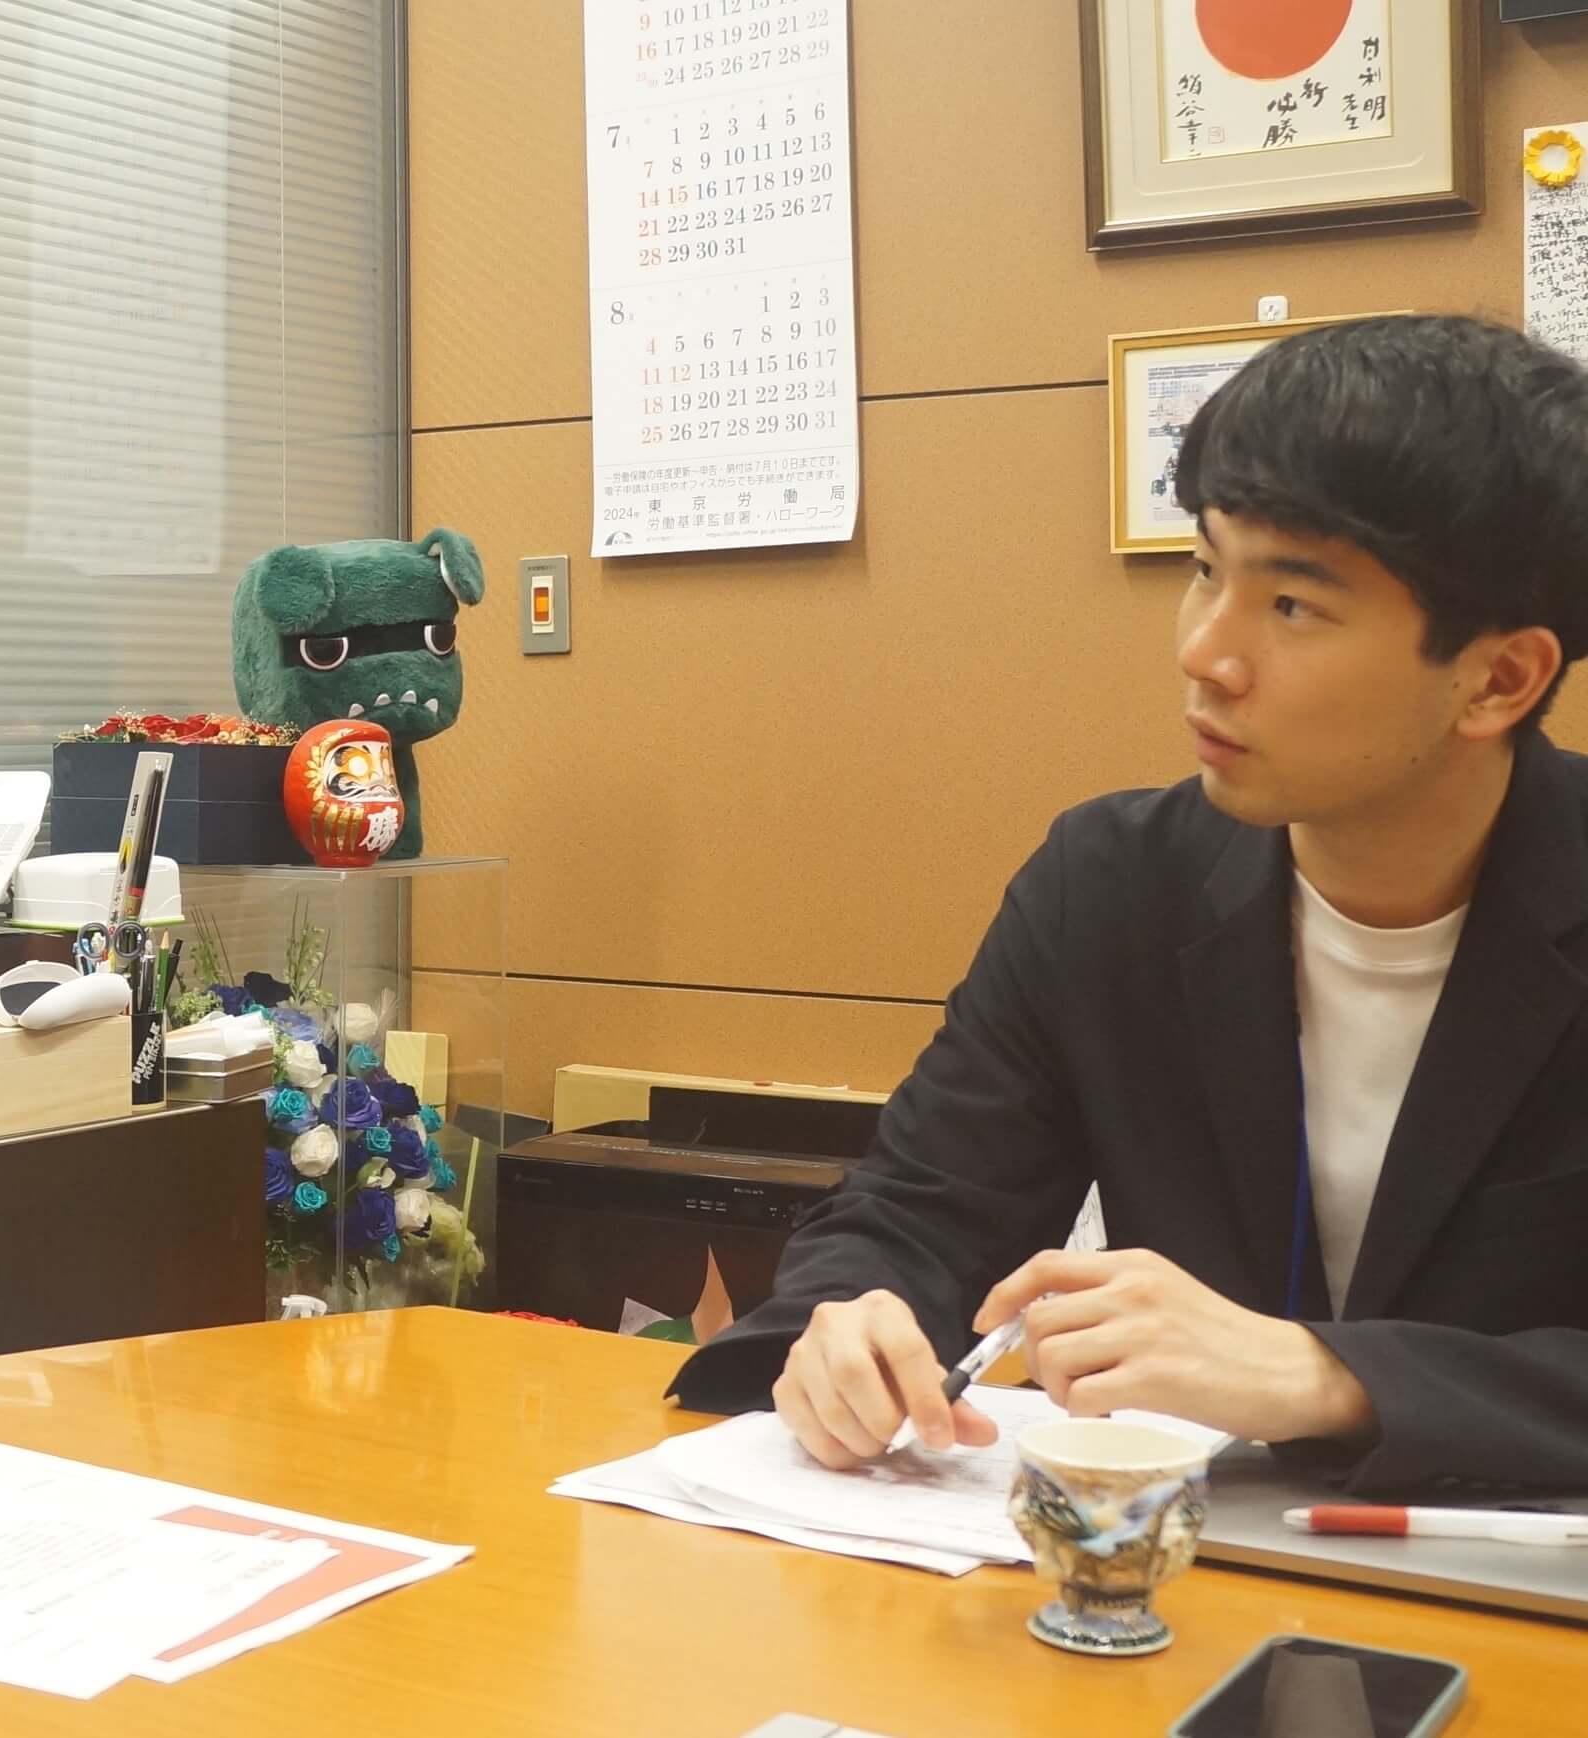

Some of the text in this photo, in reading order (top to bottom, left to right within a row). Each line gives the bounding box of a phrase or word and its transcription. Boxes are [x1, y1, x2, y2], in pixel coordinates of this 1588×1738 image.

[638, 9, 828, 60] 16 17 18 19 20 21 22
[640, 14, 650, 30] 9
[666, 8, 684, 26] 10
[693, 3, 711, 21] 11
[722, 0, 741, 16] 12
[665, 66, 684, 85] 24
[693, 61, 713, 80] 25
[721, 56, 742, 75] 26
[750, 50, 771, 70] 27
[779, 45, 800, 64] 28
[808, 40, 829, 59] 29
[674, 128, 680, 144] 1
[700, 123, 709, 140] 2
[729, 118, 738, 135] 3
[756, 113, 767, 130] 4
[786, 108, 795, 125] 5
[815, 103, 825, 120] 6
[644, 132, 831, 177] 7 8 9 10 11 12 13
[641, 163, 832, 208] 14 15 16 17 18 19 20
[639, 193, 832, 237] 21 22 23 24 25 26 27
[640, 237, 745, 266] 28 29 30 31
[762, 296, 770, 312] 1
[790, 292, 800, 309] 2
[819, 288, 829, 305] 3
[645, 318, 836, 355] 4 5 6 7 8 9 10
[644, 349, 836, 385] 11 12 13 14 15 16 17
[644, 380, 836, 414] 18 19 20 21 22 23 24
[642, 410, 837, 444] 25 26 27 28 29 30 31
[131, 1021, 160, 1084] PUZZLE
